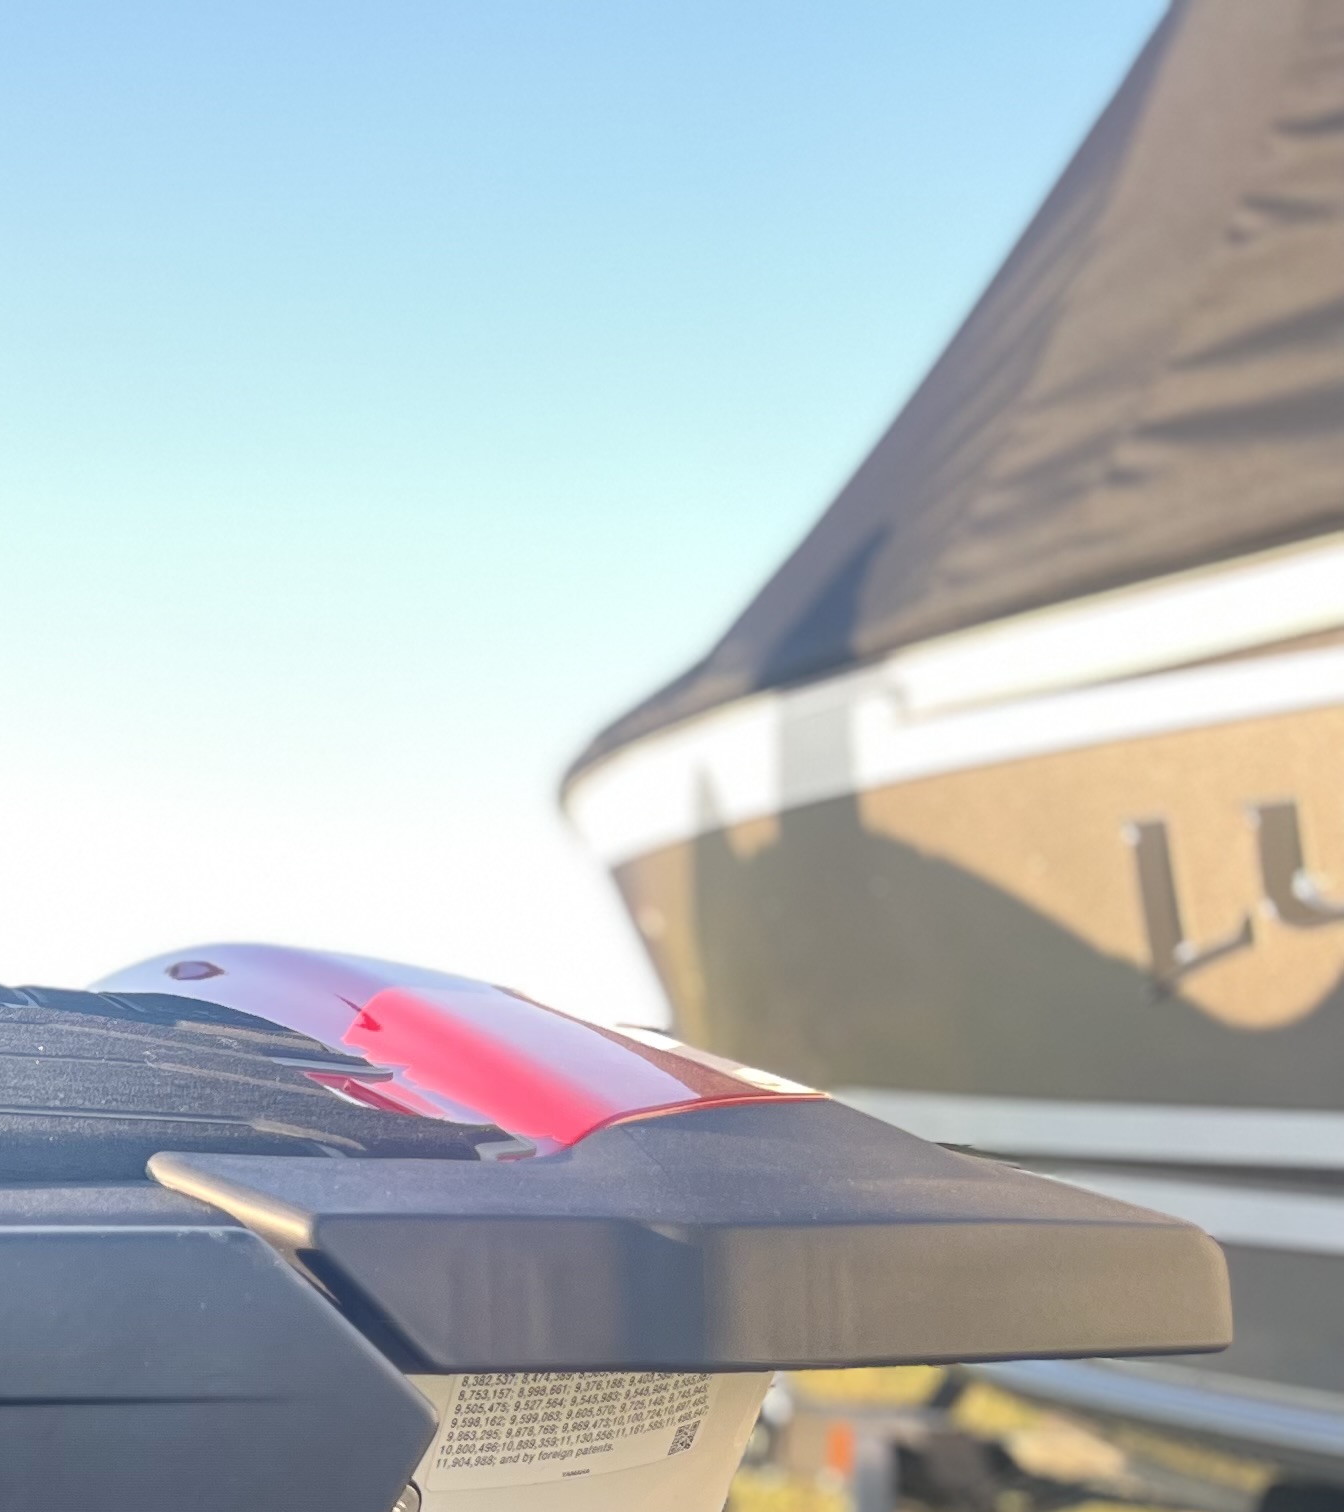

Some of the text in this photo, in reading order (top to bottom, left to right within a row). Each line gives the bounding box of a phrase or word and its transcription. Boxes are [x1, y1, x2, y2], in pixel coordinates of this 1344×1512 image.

[500, 1453, 520, 1464] and
[522, 1453, 536, 1464] by
[538, 1449, 574, 1460] foreign
